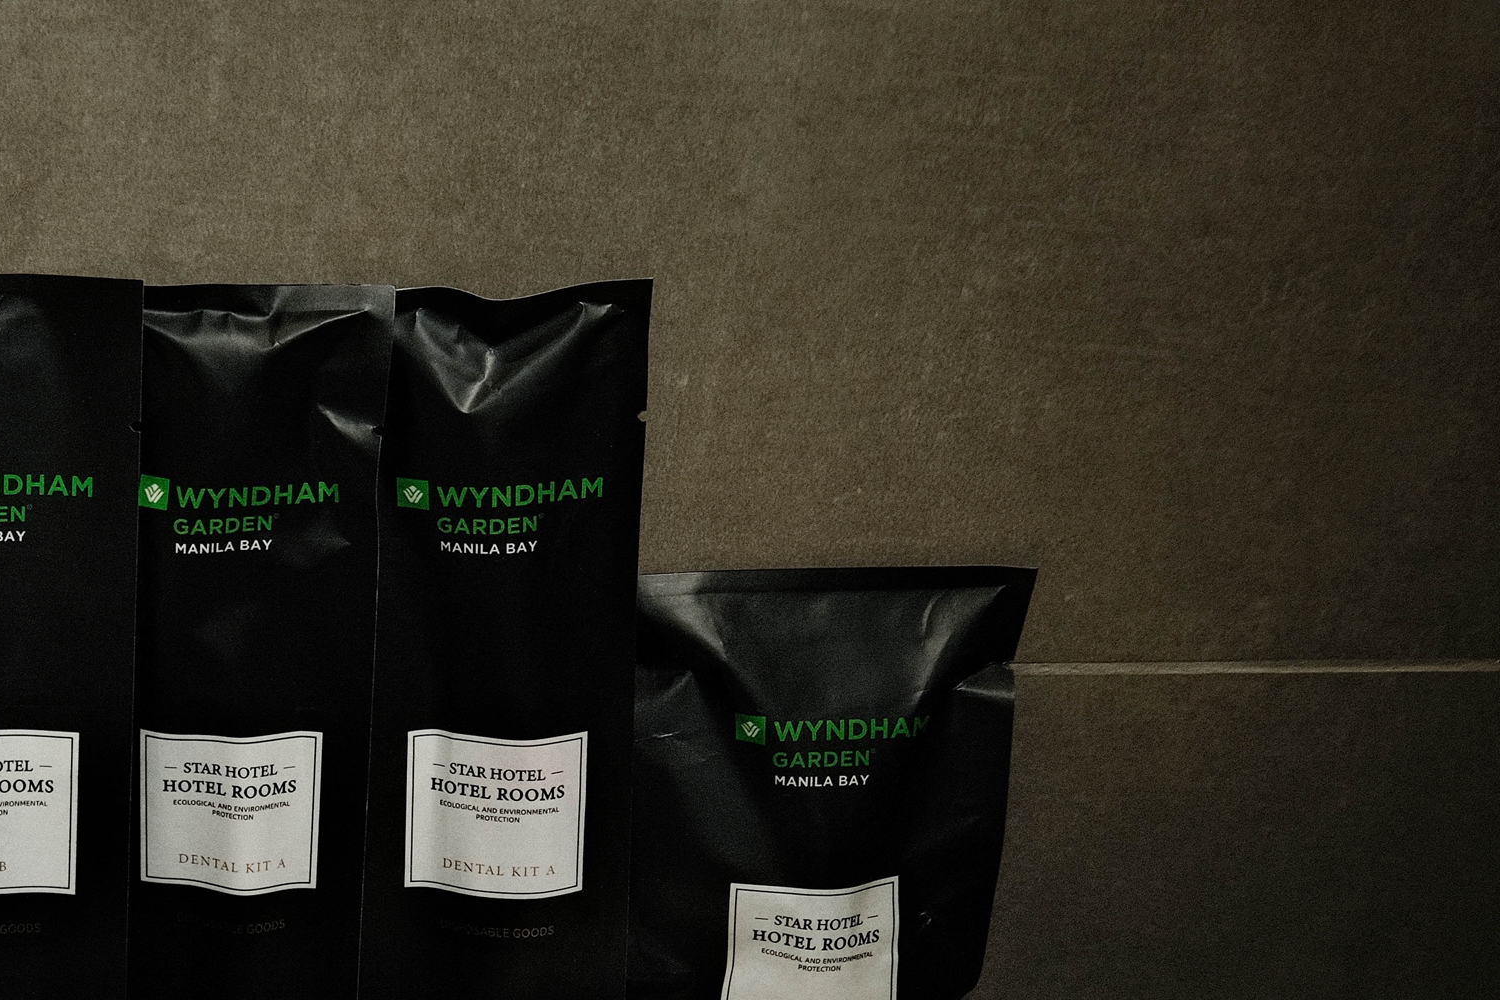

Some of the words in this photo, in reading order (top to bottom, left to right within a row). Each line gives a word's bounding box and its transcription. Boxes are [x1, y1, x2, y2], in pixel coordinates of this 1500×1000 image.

[176, 481, 339, 509] WYNDHAM
[437, 477, 603, 508] WYNDHAM
[175, 541, 235, 554] MANILA
[240, 539, 272, 551] BAY
[440, 541, 500, 555] MANILA
[506, 540, 537, 554] BAY
[774, 715, 930, 741] WYNDHAM
[183, 762, 222, 776] STAR
[225, 764, 278, 779] HOTEL
[449, 762, 487, 779] STAR
[490, 768, 546, 782] HOTEL
[774, 775, 833, 787] MANILA
[838, 774, 870, 786] BAY
[163, 780, 226, 797] HOTEL
[232, 780, 297, 799] ROOMS
[431, 778, 491, 799] HOTEL
[497, 785, 565, 802] ROOMS
[173, 800, 216, 809] ECOLOGICAL
[218, 803, 232, 811] AND
[234, 801, 290, 813] ENVIRONMENTAL
[440, 800, 479, 812] ECOLOGICAL
[500, 807, 559, 815] ENVIRONMENTAL
[212, 810, 254, 821] PROTECTION
[476, 814, 520, 823] PROTECTION
[179, 854, 238, 873] DENTAL
[246, 860, 271, 873] KIT
[277, 858, 286, 868] A
[443, 857, 504, 876] DENTAL
[512, 866, 539, 877] KIT
[546, 866, 556, 875] A
[774, 915, 813, 930] STAR
[817, 914, 863, 931] HOTEL
[752, 930, 816, 951] HOTEL
[821, 929, 880, 951] ROOMS
[761, 948, 803, 962] ECOLOGICAL
[823, 951, 873, 964] ENVIRONMENTAL
[798, 964, 841, 972] PROTECTION
